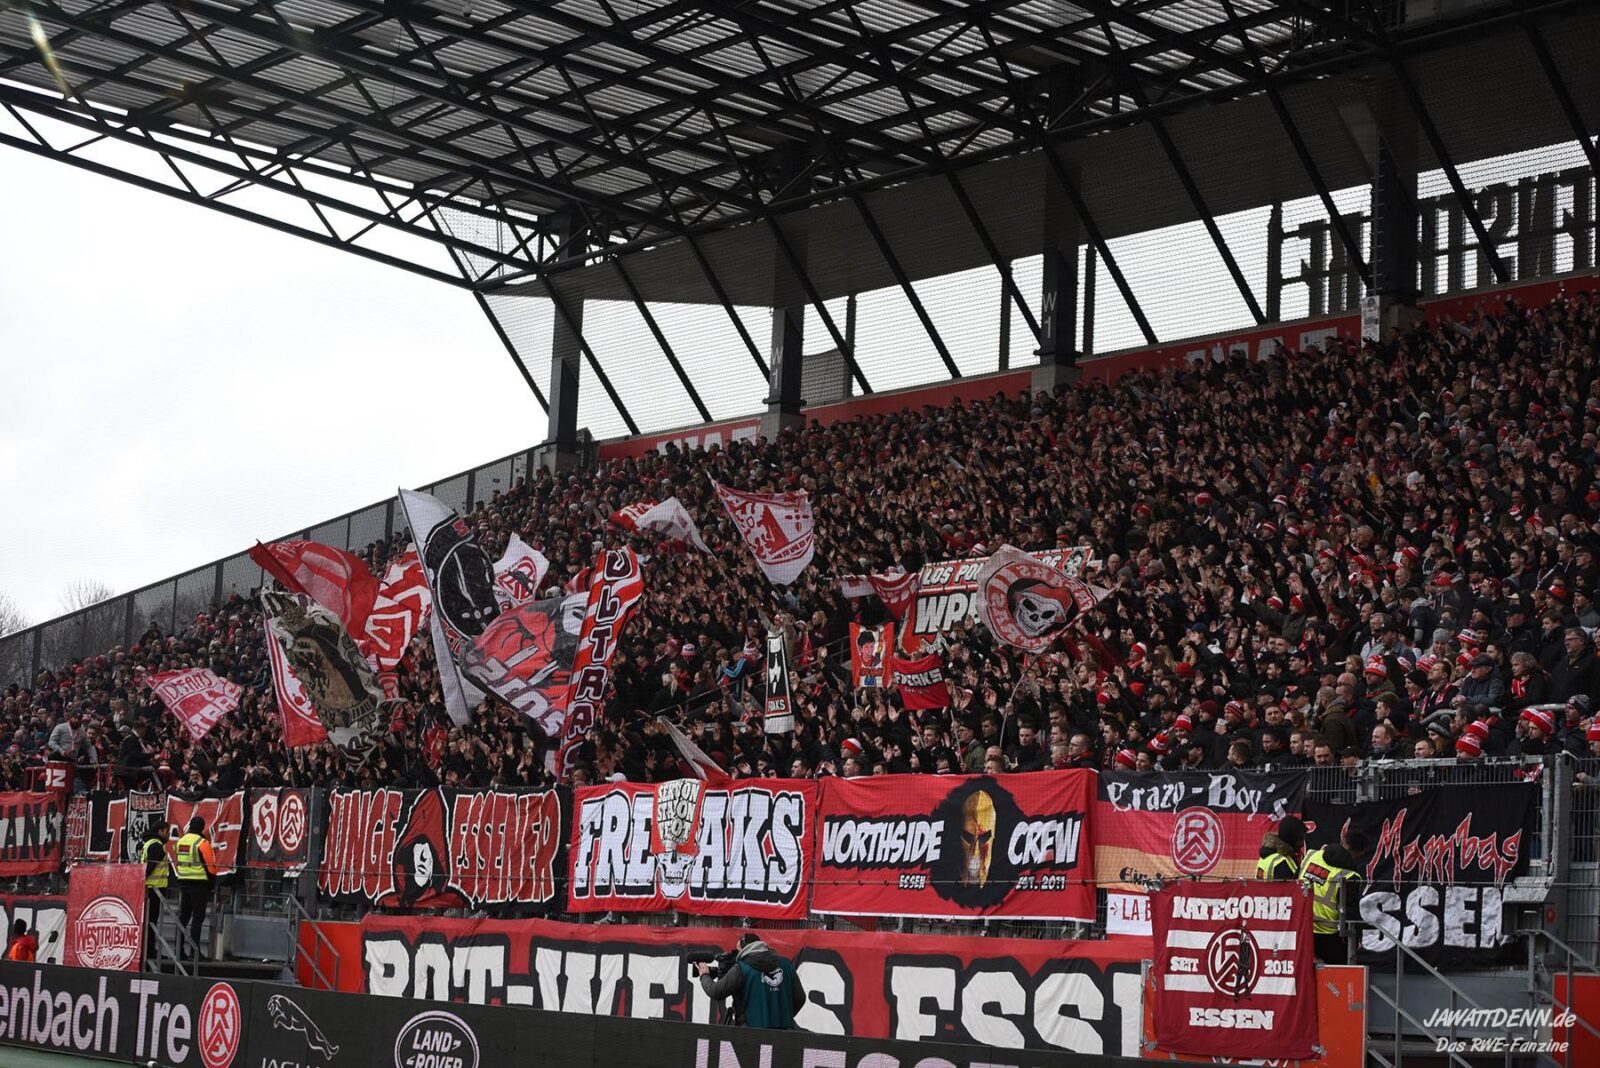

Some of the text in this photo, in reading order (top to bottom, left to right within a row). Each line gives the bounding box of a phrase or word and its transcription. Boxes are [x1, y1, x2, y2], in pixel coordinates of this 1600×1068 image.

[317, 786, 403, 899] JUNGE
[449, 788, 562, 903] ESSENER
[574, 788, 804, 906] FREAKS
[822, 819, 945, 865] NORTHSIDE
[1007, 818, 1081, 867] CREW
[898, 874, 928, 890] ESSEN
[1040, 875, 1067, 890] 2011
[1172, 896, 1293, 921] KATEGORIE
[1170, 956, 1295, 976] SEIT 2015
[130, 979, 192, 1063] Tre
[1189, 1007, 1275, 1030] ESSEN
[412, 1028, 453, 1053] LAND
[415, 1052, 464, 1068] ROVER
